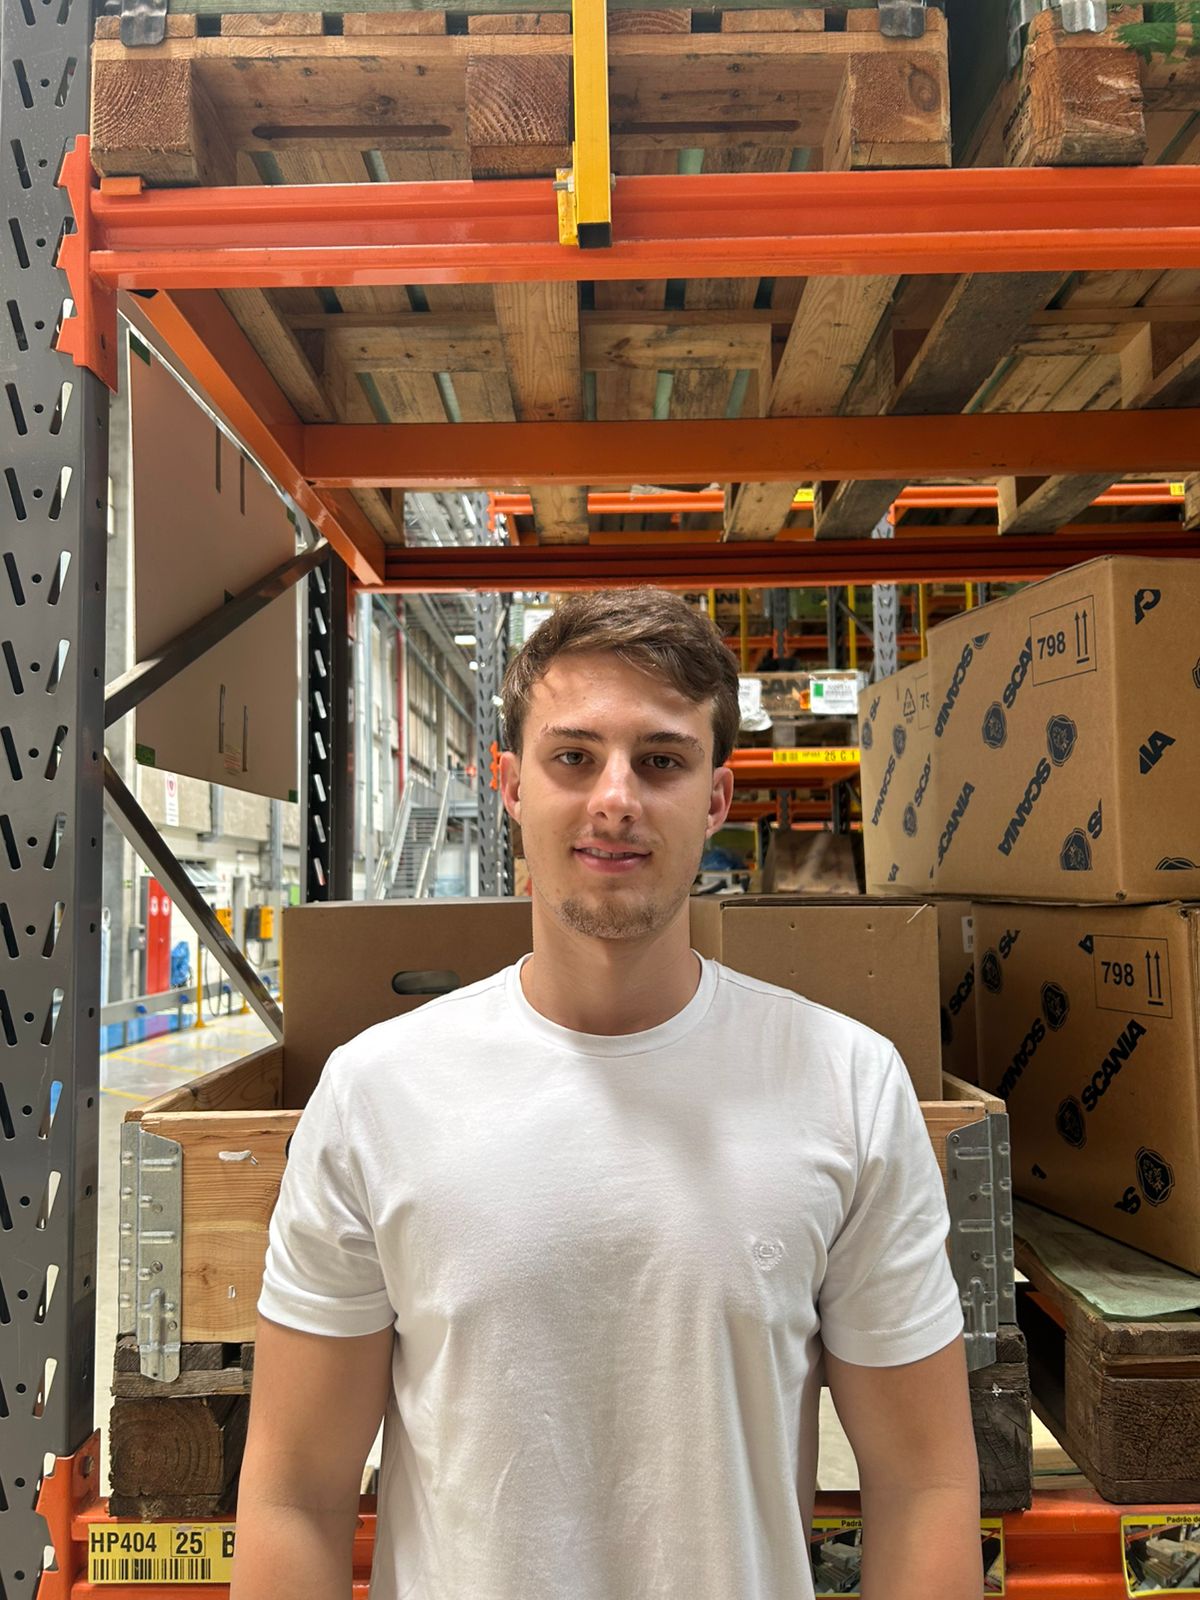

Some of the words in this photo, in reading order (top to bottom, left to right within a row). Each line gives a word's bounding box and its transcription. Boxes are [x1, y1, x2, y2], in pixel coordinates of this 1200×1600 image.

[1037, 631, 1066, 660] 798
[935, 643, 973, 737] SCANIA
[872, 754, 896, 826] SCANIA
[997, 757, 1051, 856] SCANIA
[1101, 961, 1135, 987] 798
[1081, 1019, 1147, 1112] SCANIA
[91, 1532, 157, 1553] HP404
[175, 1532, 203, 1554] 25
